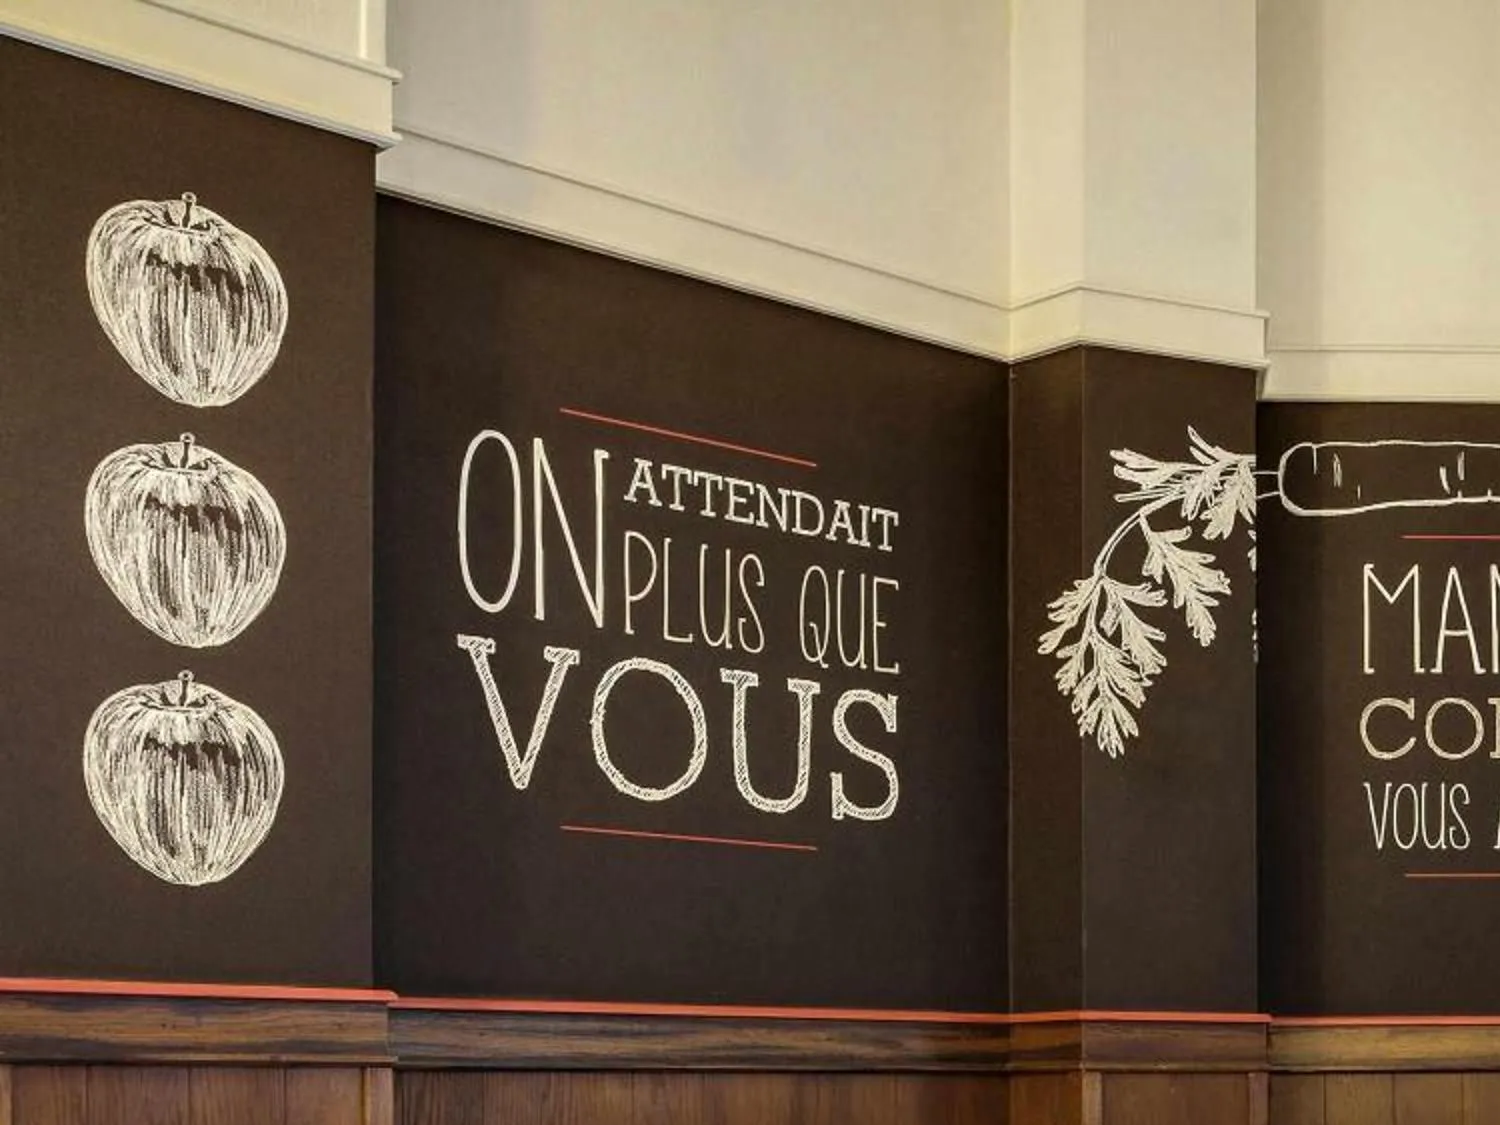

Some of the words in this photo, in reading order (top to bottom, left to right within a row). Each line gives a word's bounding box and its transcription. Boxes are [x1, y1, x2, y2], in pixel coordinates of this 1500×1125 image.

[458, 430, 609, 628] ON
[624, 458, 899, 551] ATTENDAIT
[624, 531, 765, 654] PLUS
[800, 565, 899, 674] QUE
[457, 634, 899, 821] VOUS
[1363, 782, 1471, 850] VOUS
